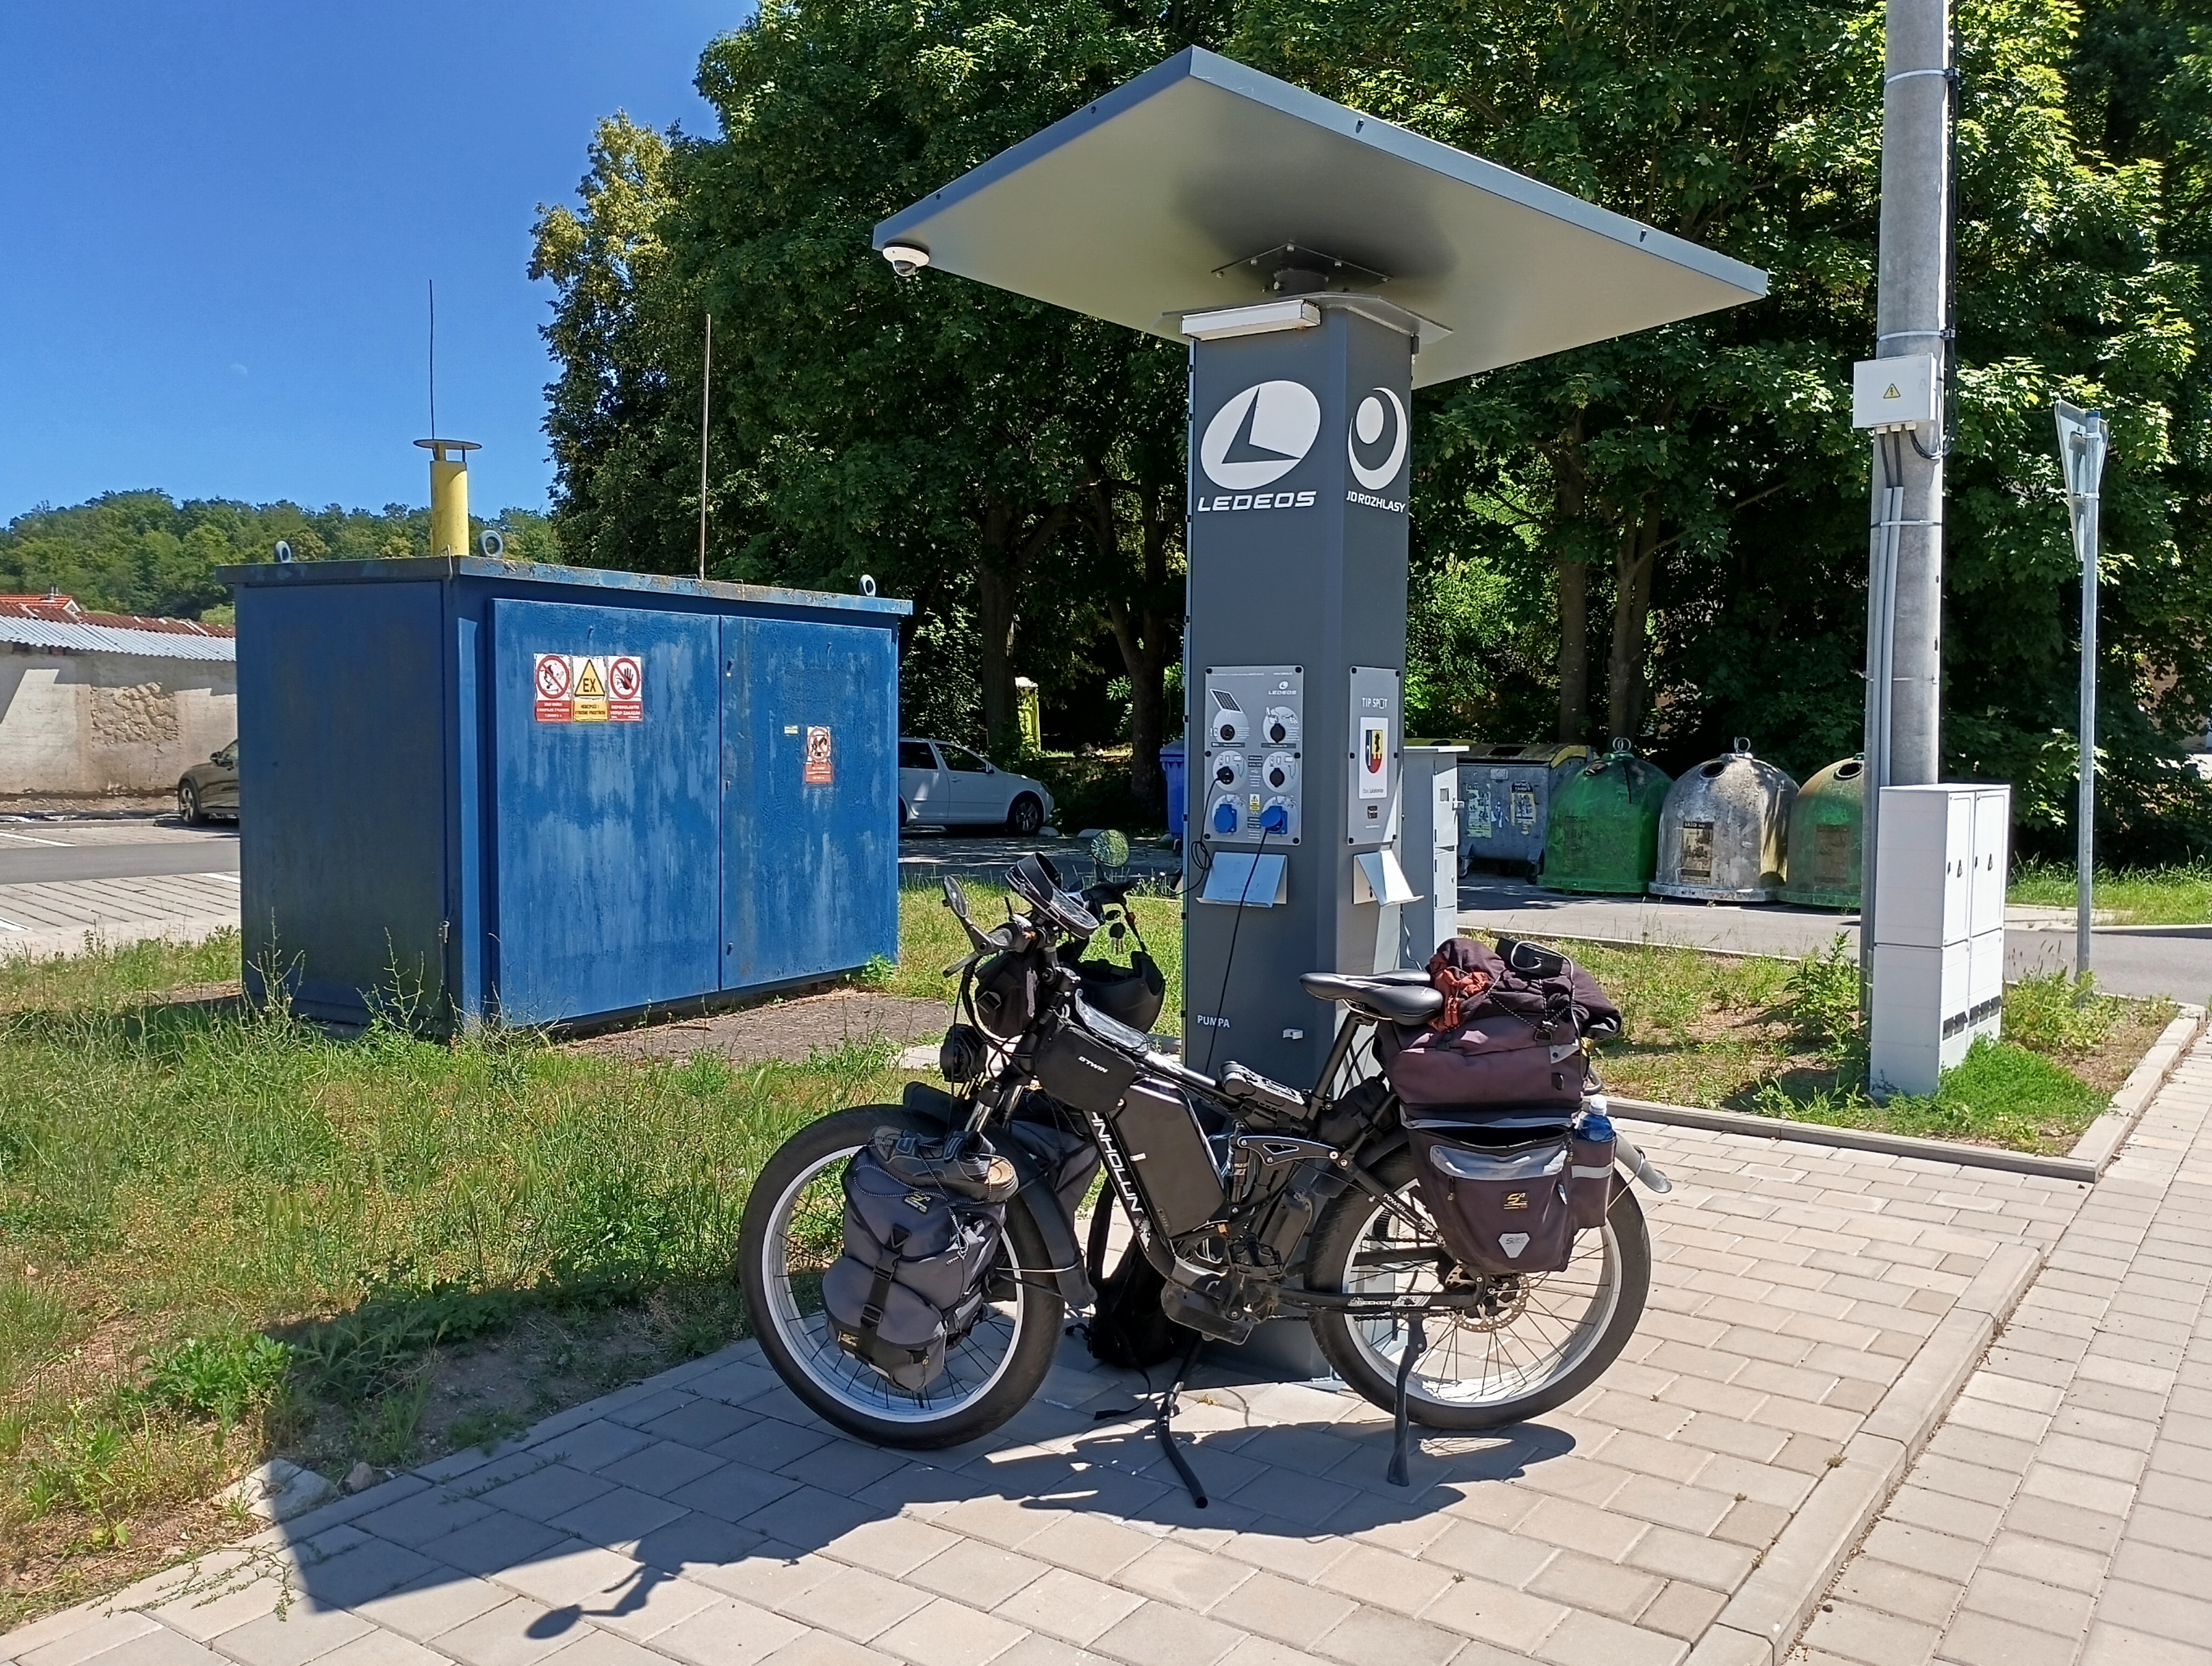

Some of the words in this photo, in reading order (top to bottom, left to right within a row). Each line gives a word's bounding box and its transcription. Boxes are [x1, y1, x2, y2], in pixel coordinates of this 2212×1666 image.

[1197, 490, 1317, 512] LEDEOS
[1358, 493, 1406, 513] ROZHLASY
[583, 678, 596, 693] EX
[1361, 697, 1372, 707] TIP
[1372, 698, 1388, 709] SPOT
[1197, 1014, 1230, 1028] PUMPA
[1383, 1193, 1406, 1213] POWER
